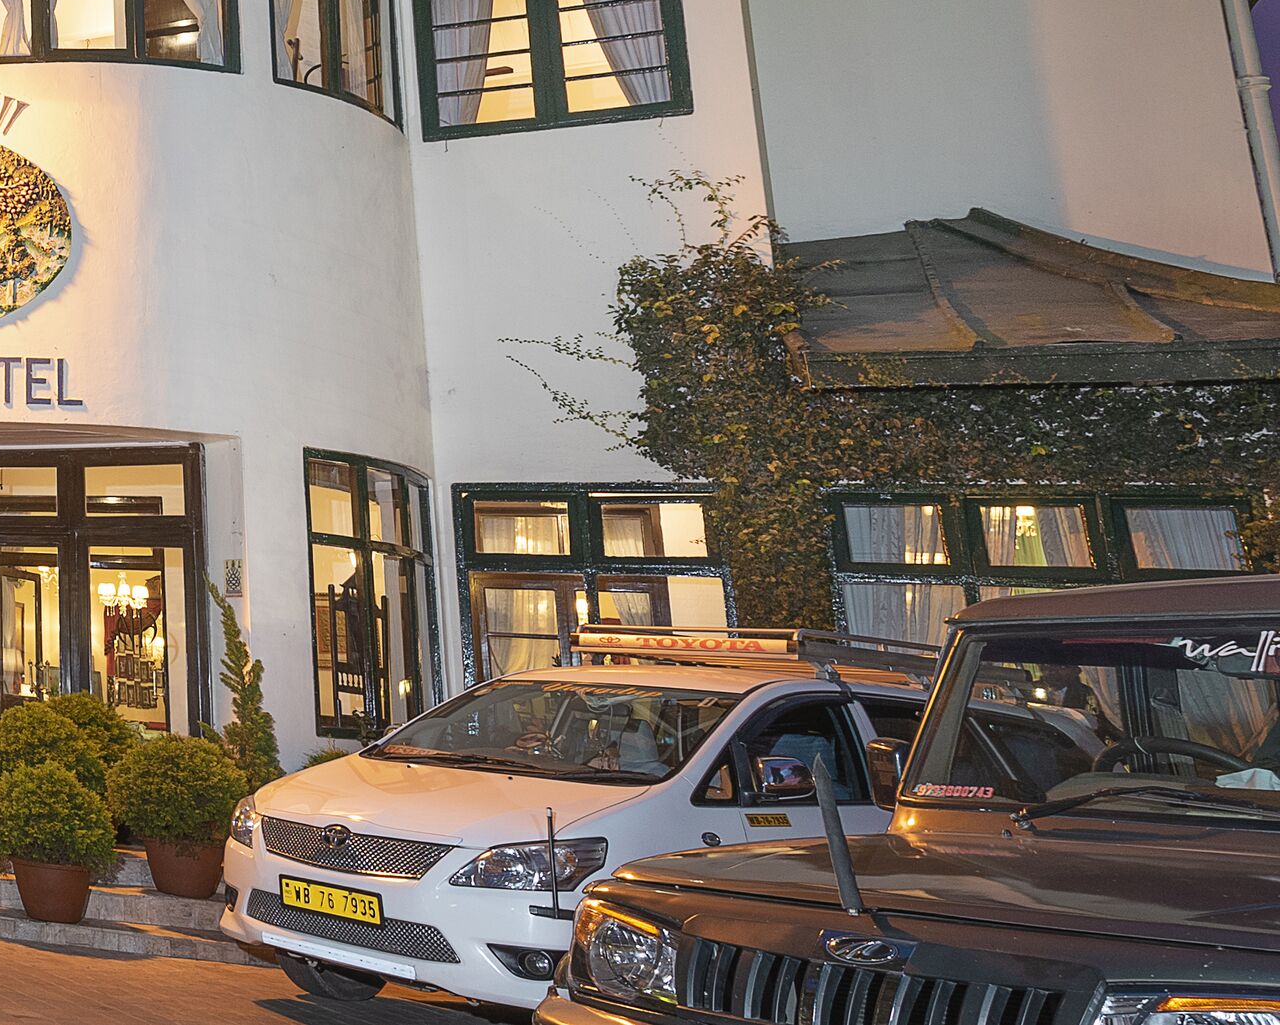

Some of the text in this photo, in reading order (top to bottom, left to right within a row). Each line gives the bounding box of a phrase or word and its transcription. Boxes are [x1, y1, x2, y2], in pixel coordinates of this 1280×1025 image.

[635, 636, 768, 652] TOYOTA
[293, 885, 377, 919] WB 76 7935
